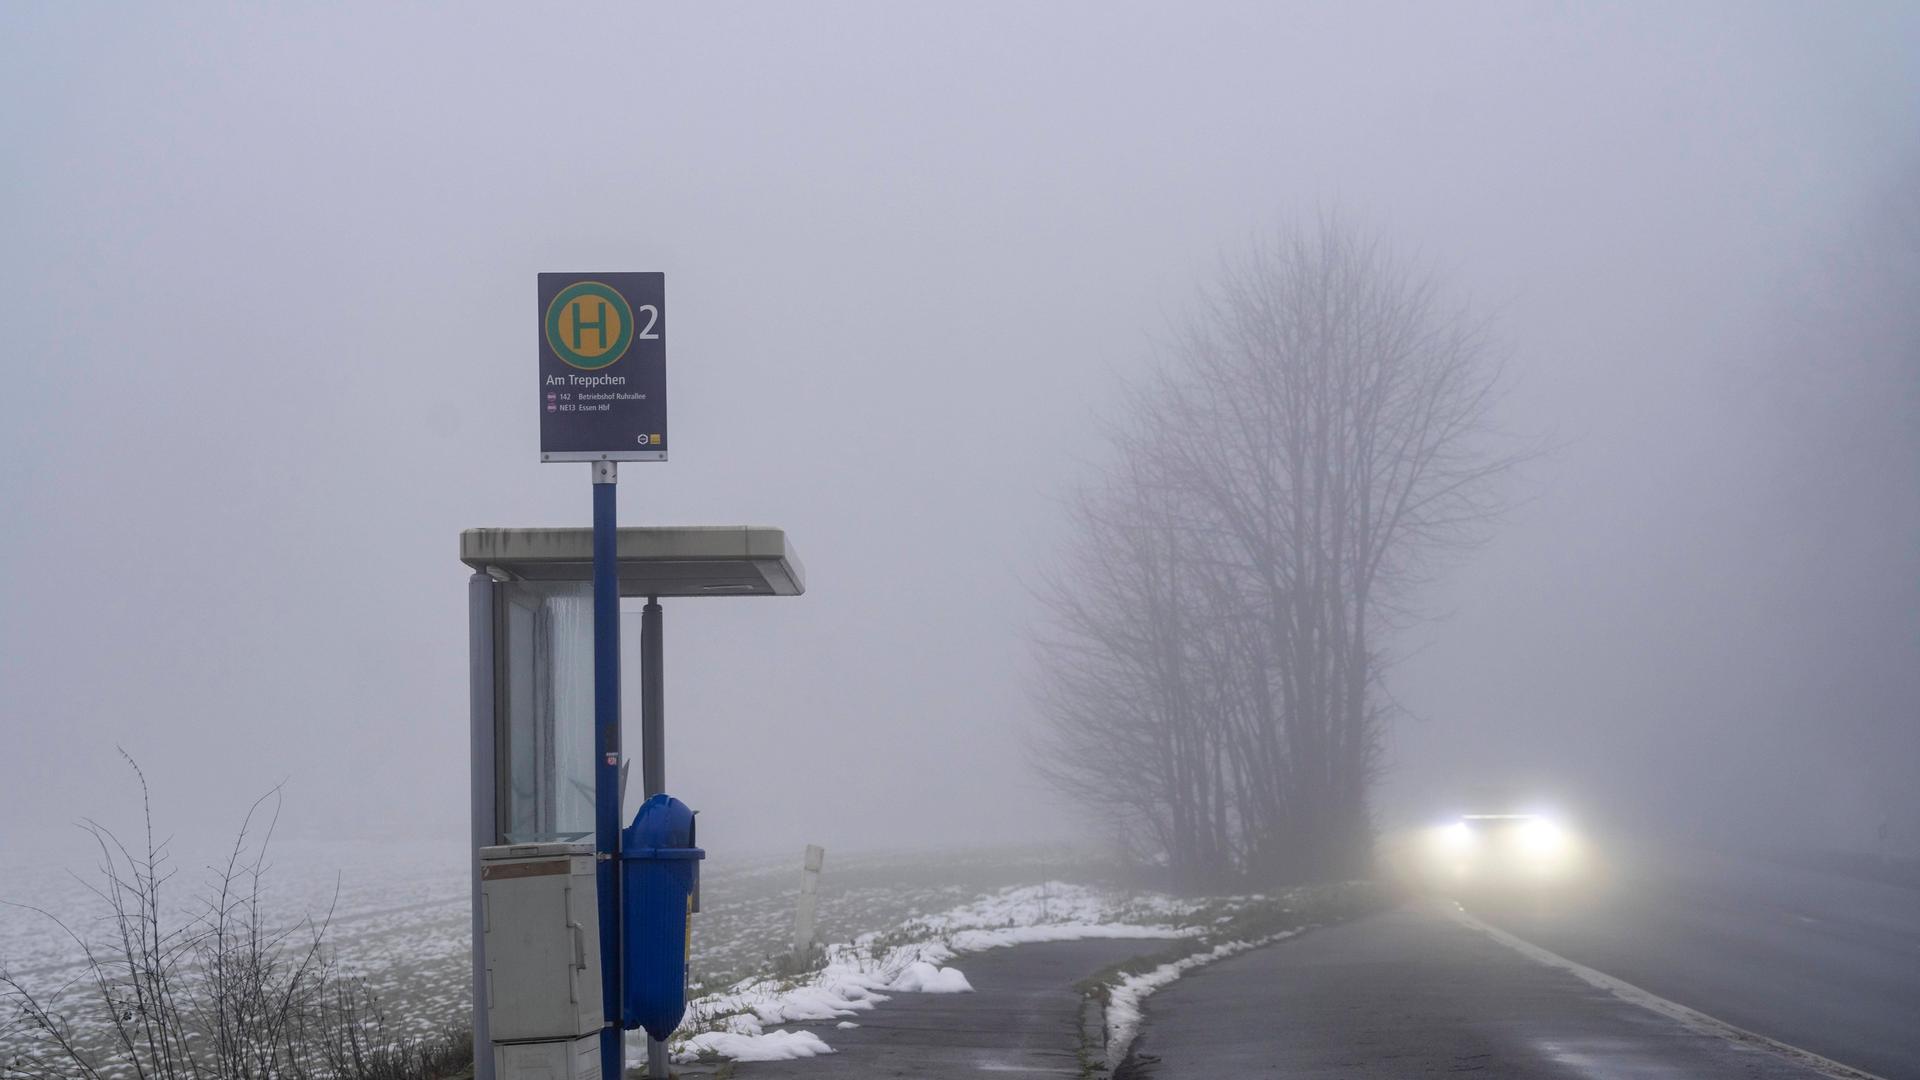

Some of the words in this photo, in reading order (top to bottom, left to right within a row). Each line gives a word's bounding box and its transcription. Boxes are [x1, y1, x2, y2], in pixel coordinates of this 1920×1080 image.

[573, 303, 606, 349] H
[639, 304, 659, 340] 2
[546, 374, 565, 385] Am
[569, 374, 625, 388] Treppchen
